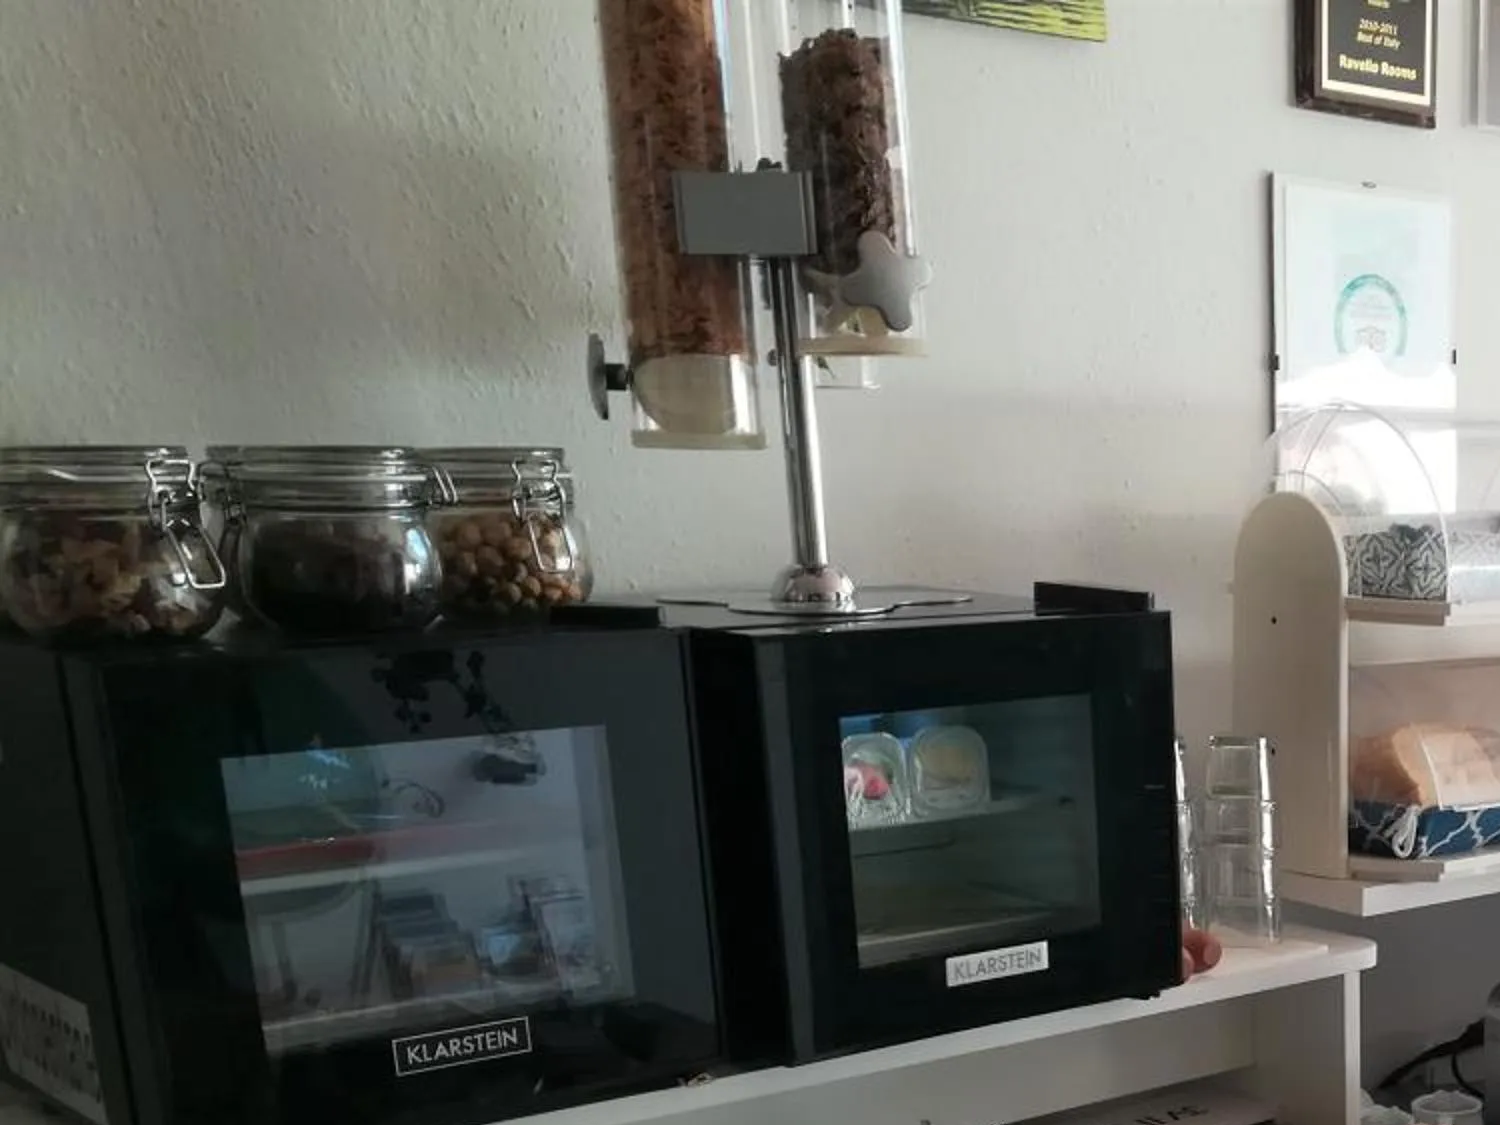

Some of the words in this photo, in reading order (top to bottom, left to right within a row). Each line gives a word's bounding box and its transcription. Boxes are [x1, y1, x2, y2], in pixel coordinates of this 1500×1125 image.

[1339, 53, 1379, 74] Ravello
[1381, 61, 1417, 80] Rooms
[953, 947, 1042, 982] KLARSTEIN
[407, 1027, 518, 1065] KLARSTEIN
